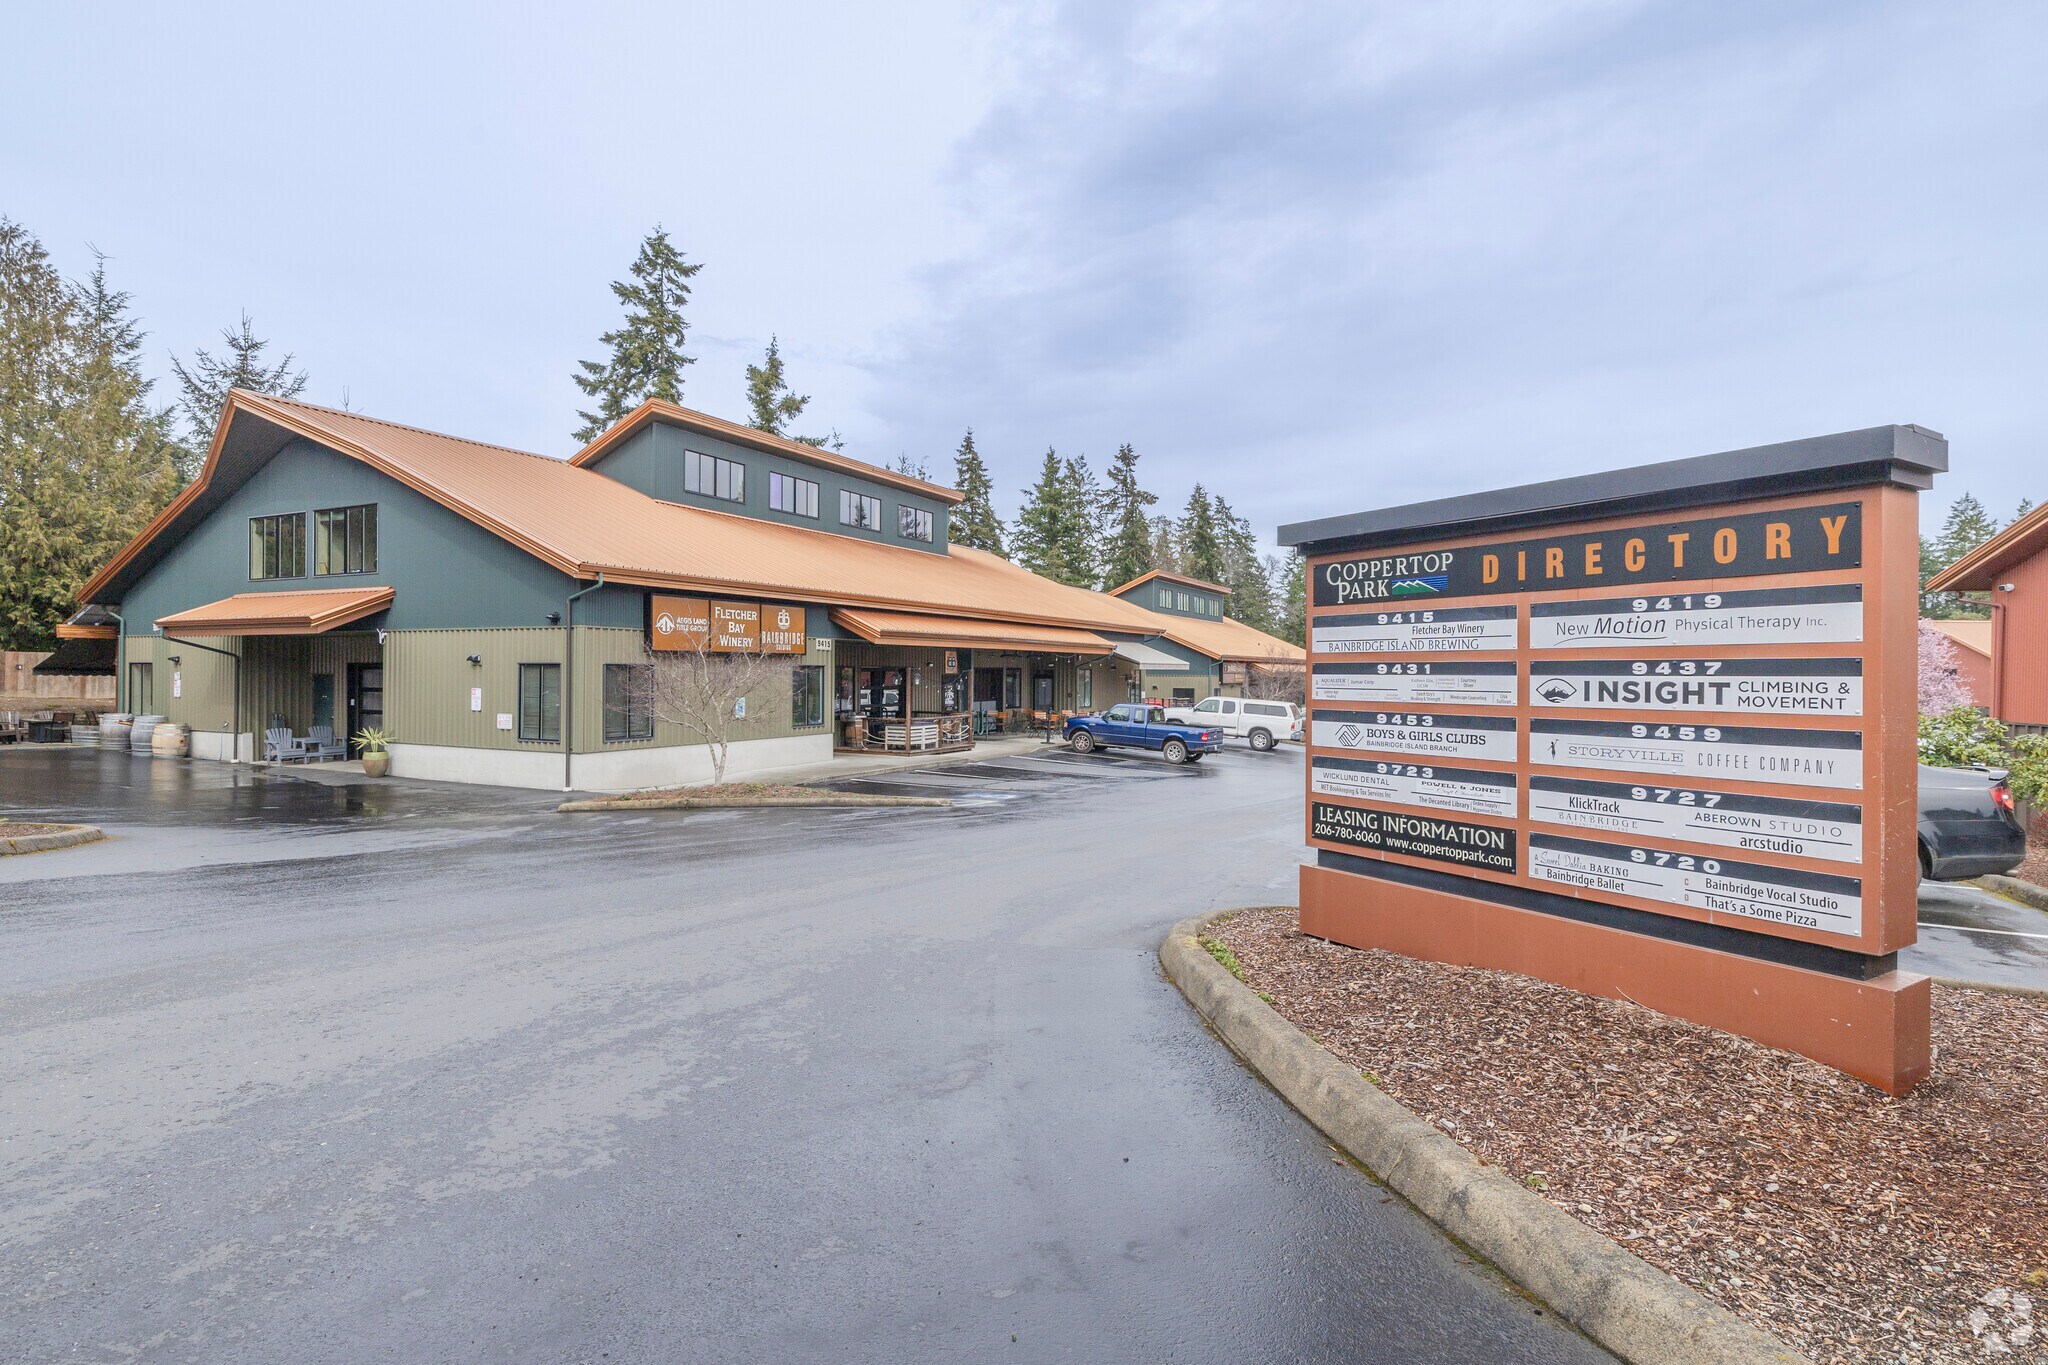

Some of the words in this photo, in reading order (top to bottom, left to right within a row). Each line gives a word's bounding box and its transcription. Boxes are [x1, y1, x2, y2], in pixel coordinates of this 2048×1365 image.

[1482, 515, 1848, 584] DIRECTORY
[1326, 552, 1454, 586] COPPERTOP
[1337, 579, 1390, 604] PARK
[1632, 594, 1722, 612] 9419
[715, 607, 757, 621] FLETCHER
[1377, 611, 1434, 625] 9415
[728, 622, 745, 634] BAY
[1412, 625, 1441, 635] Fletcher
[1442, 625, 1456, 636] Bay
[1457, 624, 1485, 635] Winery
[1556, 621, 1589, 636] New
[1593, 614, 1666, 635] Motion
[1674, 616, 1734, 633] Physical
[1737, 615, 1801, 632] Therapy
[1805, 616, 1827, 627] Inc.
[719, 634, 753, 647] WINERY
[817, 639, 831, 648] 9415
[1328, 640, 1384, 652] BAINBRIDGE
[1387, 639, 1425, 651] ISLAND
[1428, 638, 1479, 650] BREWING
[1377, 663, 1431, 675] 9431
[1631, 661, 1722, 675] 9437
[1583, 679, 1731, 706] INSIGHT
[1737, 680, 1829, 696] CLIMBING
[1838, 682, 1850, 695] &
[1737, 695, 1847, 710] MOVEMENT
[1376, 713, 1433, 727] 9453
[1366, 728, 1395, 740] BOYS
[1397, 729, 1406, 740] &
[1408, 730, 1443, 744] GIRLS
[1446, 733, 1486, 746] CLUBS
[1631, 724, 1722, 742] 9459
[1366, 740, 1403, 750] BAINBRIDGE
[1404, 742, 1428, 751] ISLAND
[1429, 743, 1458, 753] BRANCH
[1568, 745, 1684, 763] STORYVILLE
[1698, 751, 1749, 770] COFFEE
[1760, 755, 1835, 776] COMPANY
[1323, 772, 1359, 782] WICKLUND
[1360, 775, 1390, 785] DENTAL
[1376, 763, 1433, 778] 9723
[1367, 789, 1384, 798] Services
[1421, 780, 1457, 790] POWELL
[1469, 786, 1501, 794] JONES
[1419, 796, 1427, 804] The
[1428, 796, 1451, 807] Decanted
[1451, 798, 1470, 810] Library
[1569, 796, 1620, 813] KlickTrack
[1631, 787, 1721, 807] 9727
[1319, 806, 1378, 831] LEASING
[1383, 815, 1505, 850] INFORMATION
[1558, 811, 1638, 829] BAINBRIDGE
[1694, 812, 1762, 828] ABEROWN
[1769, 819, 1842, 838] STUDIO
[1315, 823, 1381, 844] 206-780-6060
[1386, 836, 1512, 867] www.coppertoppark.com
[1740, 834, 1803, 855] arcstudio
[1540, 851, 1560, 866] Sweet
[1564, 853, 1586, 870] Dahlia
[1589, 863, 1629, 877] BAKING
[1630, 849, 1721, 874] 9720
[1547, 868, 1595, 888] Bainbridge
[1597, 877, 1625, 892] Ballet
[1684, 877, 1690, 887] C
[1705, 877, 1764, 899] Bainbridge
[1766, 886, 1797, 903] Vocal
[1799, 892, 1838, 910] Studio
[1684, 893, 1690, 902] D
[1705, 895, 1737, 914] That's
[1738, 904, 1747, 915] a
[1749, 903, 1783, 921] Some
[1785, 910, 1818, 928] Pizza
